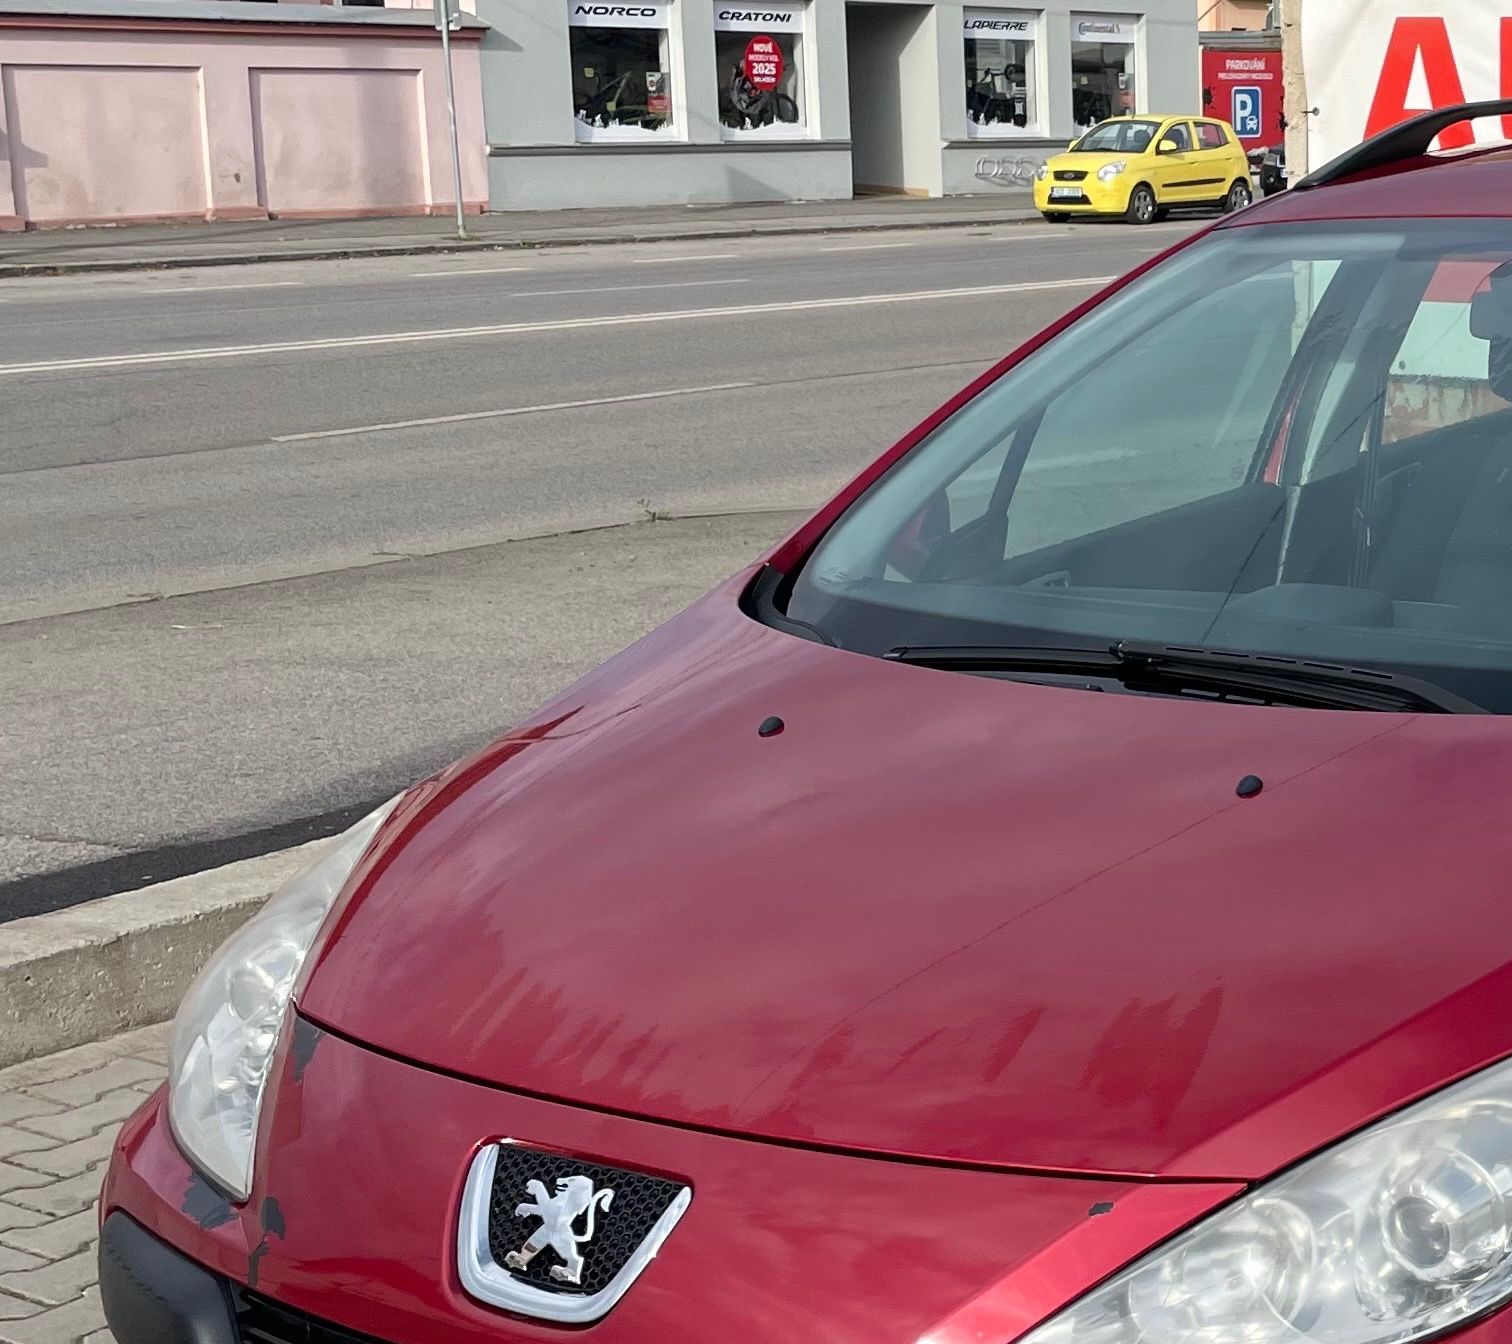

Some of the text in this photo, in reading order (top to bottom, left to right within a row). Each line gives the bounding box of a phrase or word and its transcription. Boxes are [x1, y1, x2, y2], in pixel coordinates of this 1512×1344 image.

[575, 5, 657, 17] NORCO
[718, 10, 792, 23] CRATONI
[963, 19, 1029, 32] LAPIERRE
[752, 62, 776, 75] 2025
[1235, 93, 1253, 131] P
